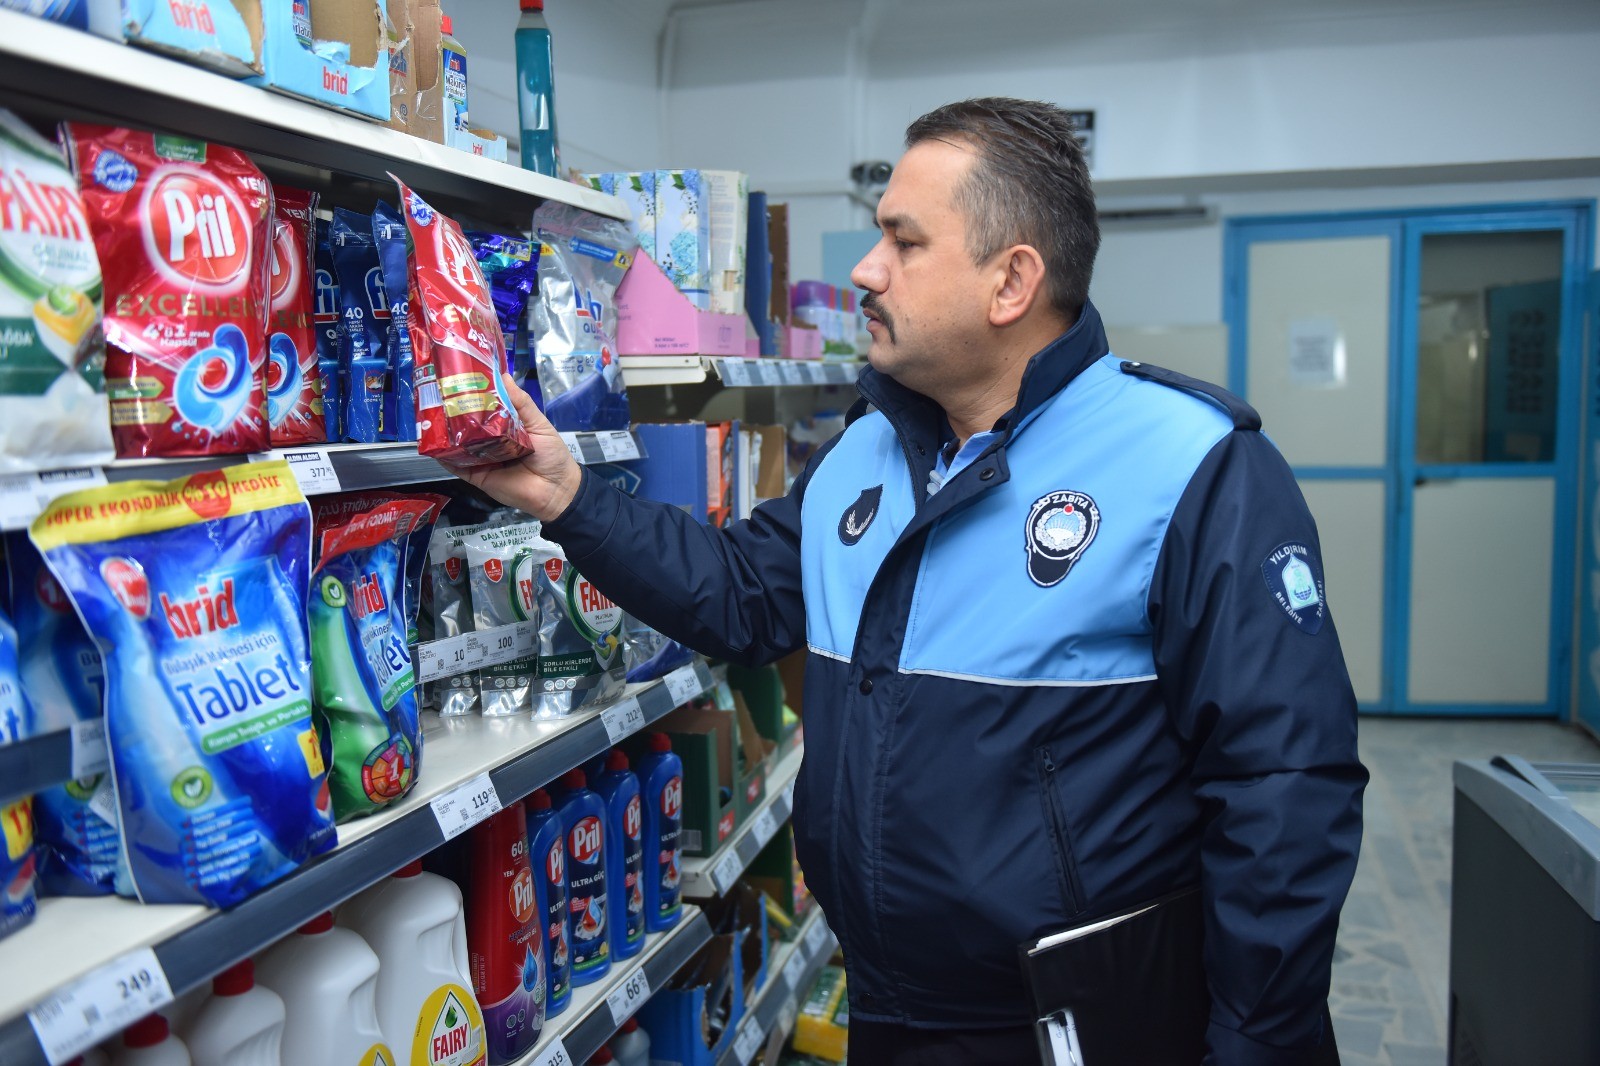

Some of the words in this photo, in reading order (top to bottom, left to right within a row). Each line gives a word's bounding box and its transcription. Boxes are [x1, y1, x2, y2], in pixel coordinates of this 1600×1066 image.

[169, 0, 216, 35] brid
[323, 66, 348, 95] brid
[163, 189, 236, 262] Pril
[344, 306, 364, 320] 40
[309, 467, 326, 478] 377
[98, 491, 181, 518] EKONOMİK
[231, 474, 282, 495] HEDİYE
[501, 526, 518, 538] TEMİZ
[1269, 544, 1308, 565] YILDIRIM
[491, 560, 497, 570] 1
[551, 560, 557, 570] 1
[159, 579, 239, 640] brid
[255, 632, 278, 651] için
[498, 635, 513, 649] 100
[493, 664, 509, 672] BİLE
[508, 661, 528, 670] ETKİLİ
[176, 653, 300, 725] Tablet
[625, 709, 639, 723] 212
[472, 790, 490, 809] 119
[511, 841, 523, 858] 60
[573, 822, 601, 858] Pril
[571, 876, 594, 888] ULTRA
[513, 872, 533, 917] Pril
[117, 968, 153, 999] 249
[626, 978, 640, 1000] 66
[433, 1023, 468, 1062] FAIRY
